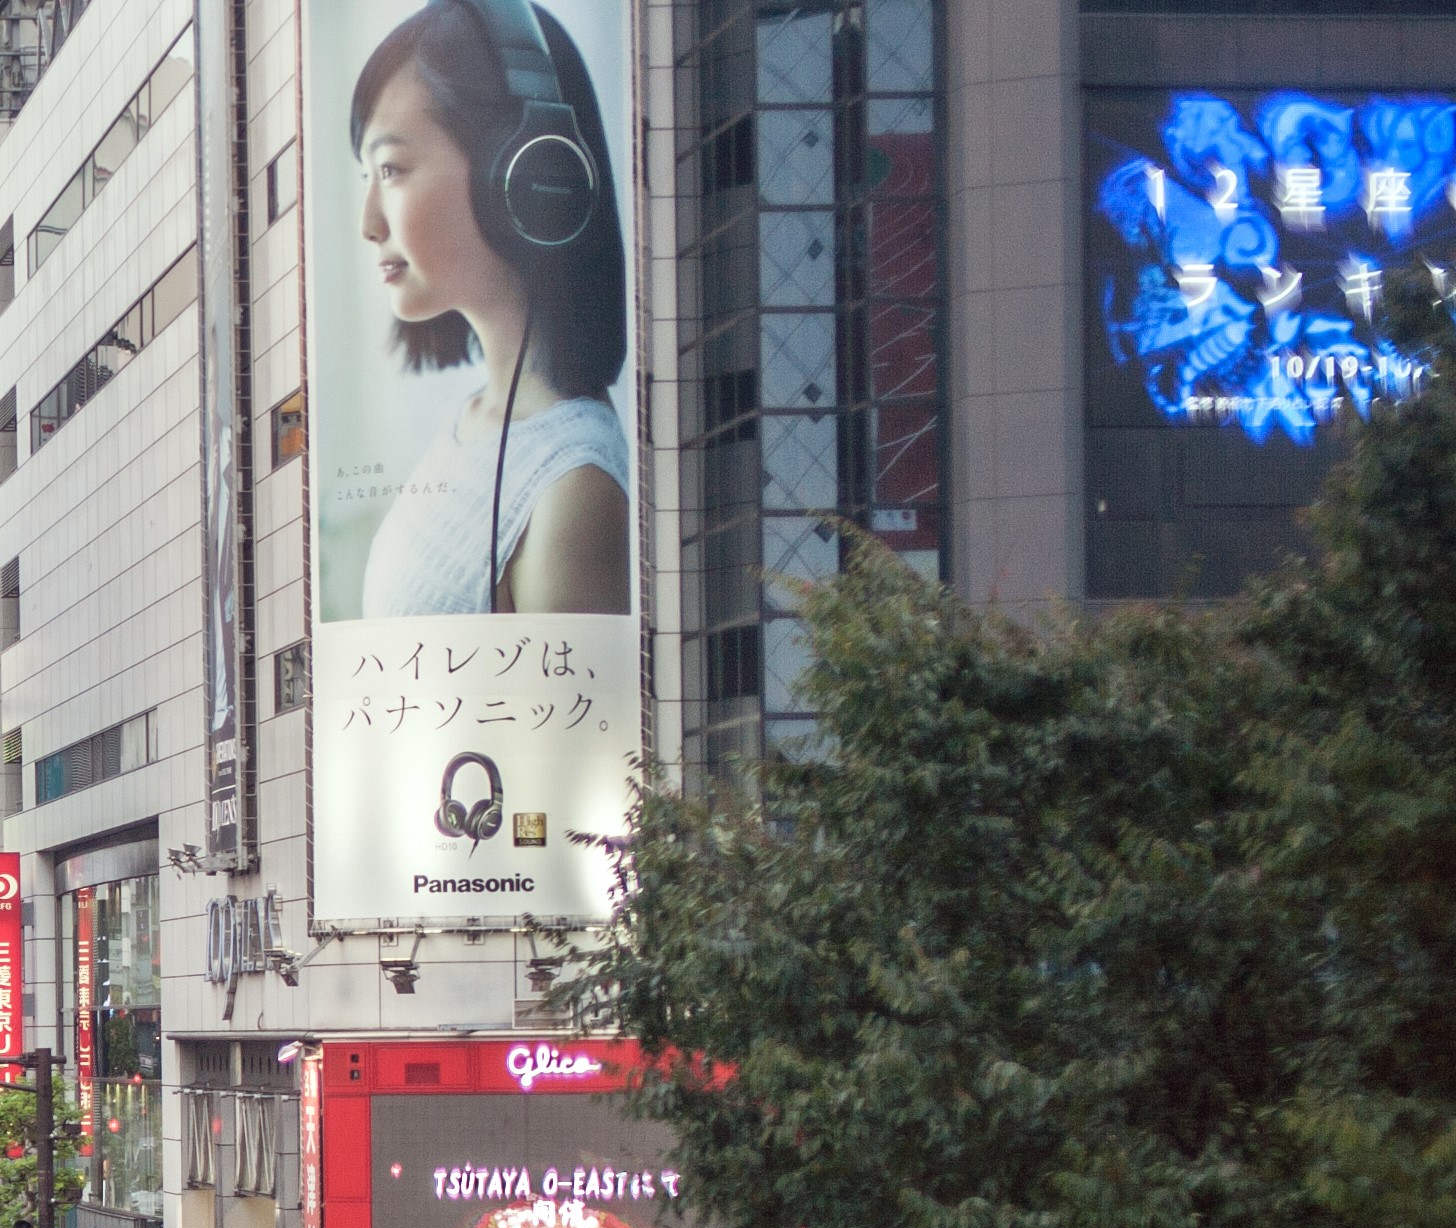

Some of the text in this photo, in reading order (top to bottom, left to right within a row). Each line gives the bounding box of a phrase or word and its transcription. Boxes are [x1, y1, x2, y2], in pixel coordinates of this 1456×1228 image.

[352, 636, 596, 681] ハイレゾは、
[342, 693, 609, 735] パナソニック。
[413, 872, 536, 893] Panasonic
[506, 1045, 602, 1089] Glico
[433, 1168, 531, 1200] TSUTAYA
